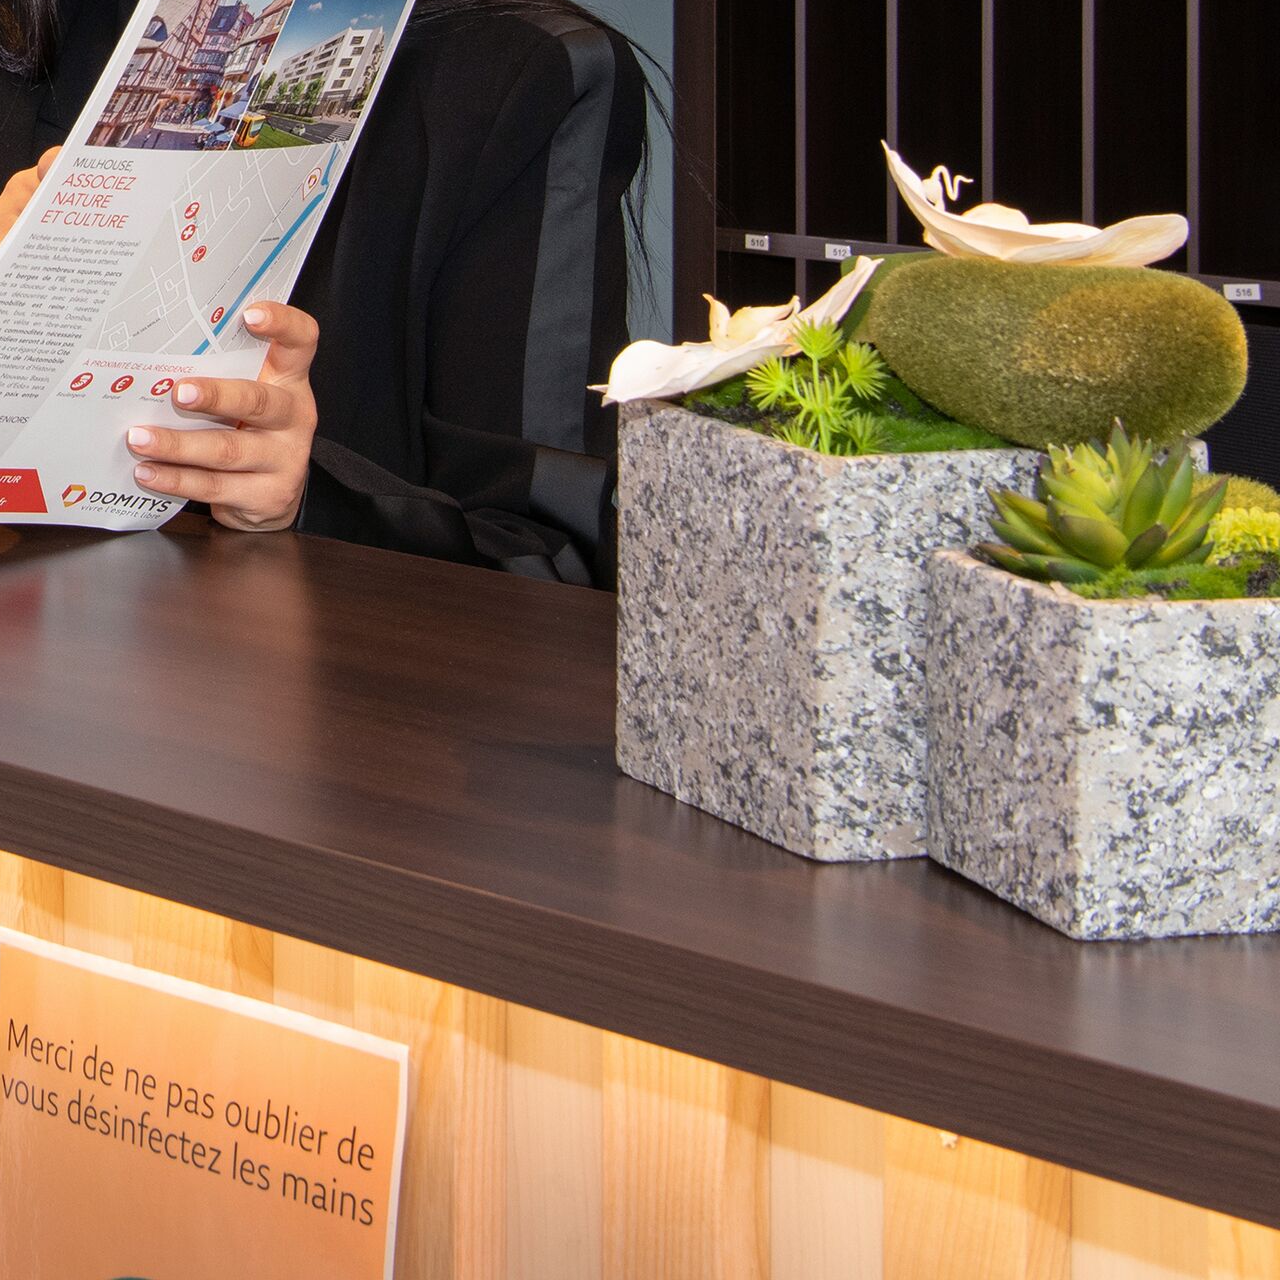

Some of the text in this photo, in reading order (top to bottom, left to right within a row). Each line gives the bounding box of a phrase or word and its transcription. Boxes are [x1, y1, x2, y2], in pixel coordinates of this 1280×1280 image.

[73, 158, 134, 172] MULHOUSE,
[62, 174, 136, 190] ASSOCIEZ
[52, 192, 113, 208] NATURE
[41, 210, 128, 228] ET CULTURE
[750, 238, 764, 247] 510
[833, 248, 846, 256] 512
[1236, 288, 1252, 297] 516
[89, 491, 172, 513] DOMITYS
[80, 504, 161, 520] vivre l'esprit libre
[7, 1018, 375, 1172] Merci de ne pas oublier de
[1, 1073, 375, 1227] vous désinfectez les mains
